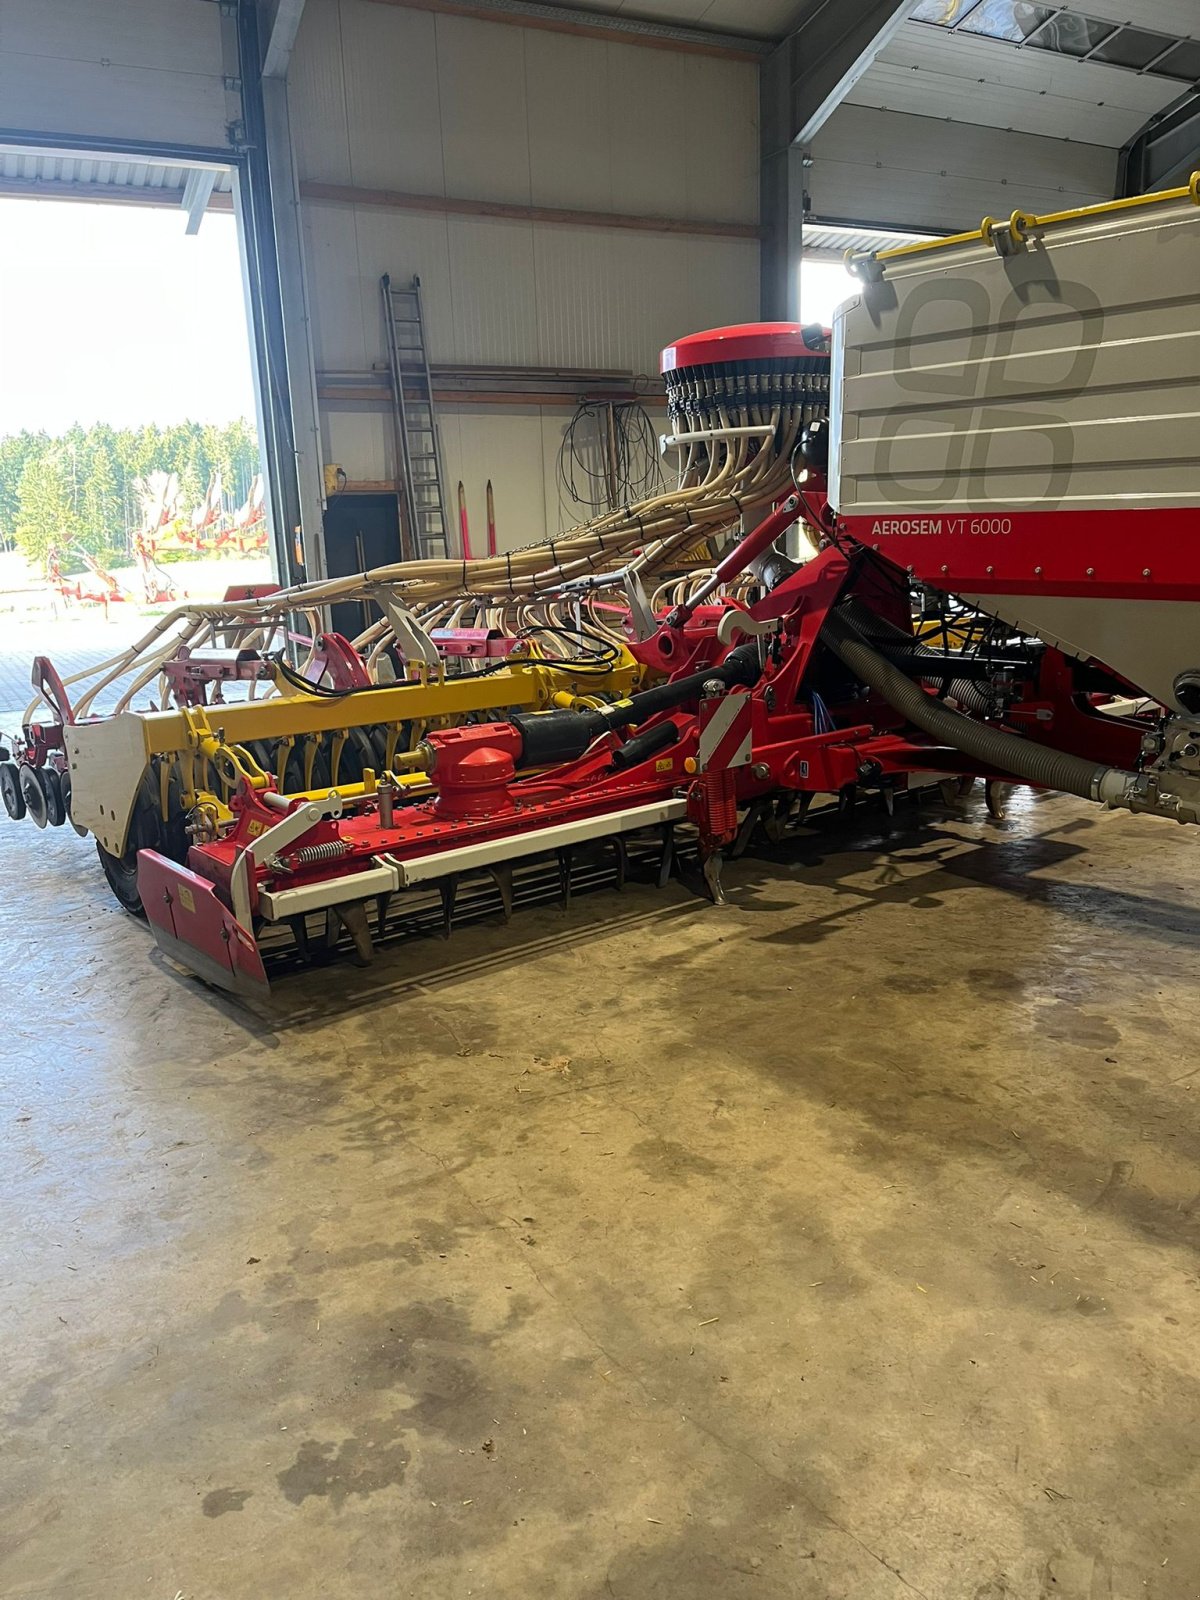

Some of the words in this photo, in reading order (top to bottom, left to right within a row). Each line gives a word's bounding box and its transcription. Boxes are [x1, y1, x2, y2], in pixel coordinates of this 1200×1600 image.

[872, 520, 942, 535] AEROSEM
[947, 519, 967, 534] VT
[970, 518, 1012, 534] 6000
